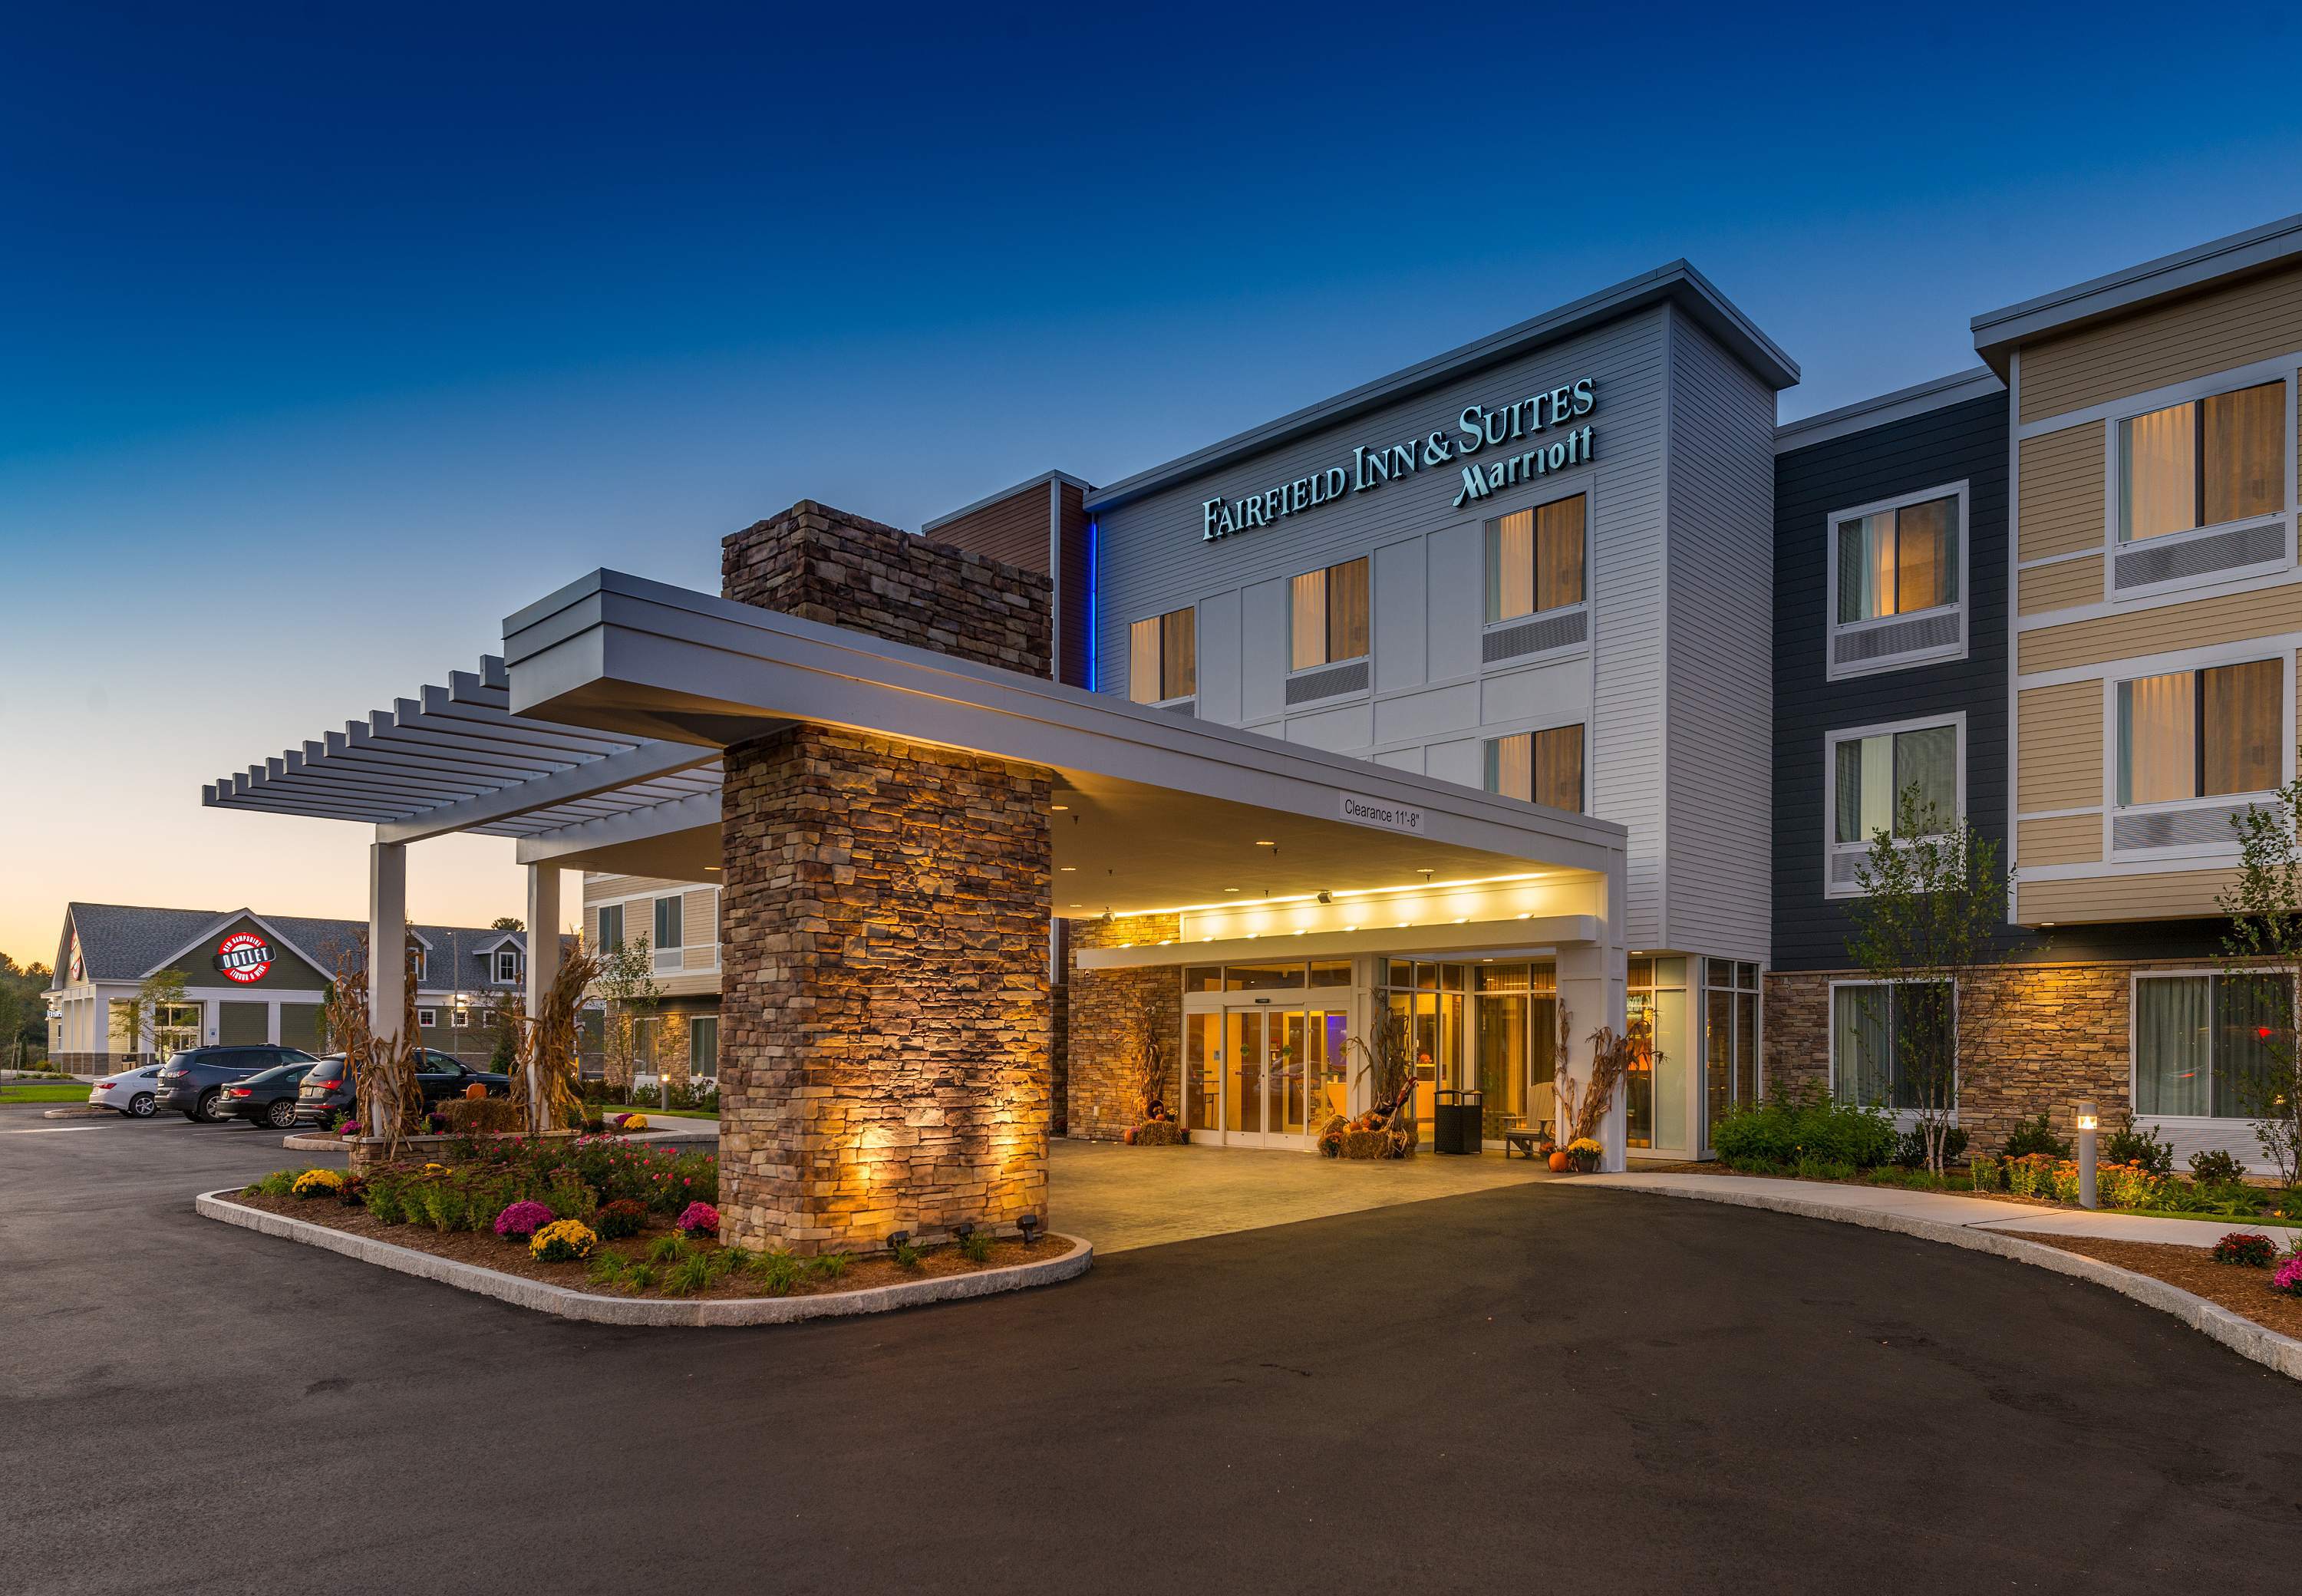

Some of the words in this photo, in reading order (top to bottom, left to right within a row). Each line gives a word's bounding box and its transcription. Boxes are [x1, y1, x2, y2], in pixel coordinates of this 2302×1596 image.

[1202, 467, 1348, 541] FAIRFIELD
[1353, 438, 1421, 493] INN
[1423, 430, 1455, 467] &
[1458, 377, 1596, 455] SUITES
[1451, 424, 1595, 508] Marriott
[1344, 799, 1392, 823] Clearance
[1395, 810, 1420, 827] 11'-8"
[223, 947, 269, 968] OUTLET
